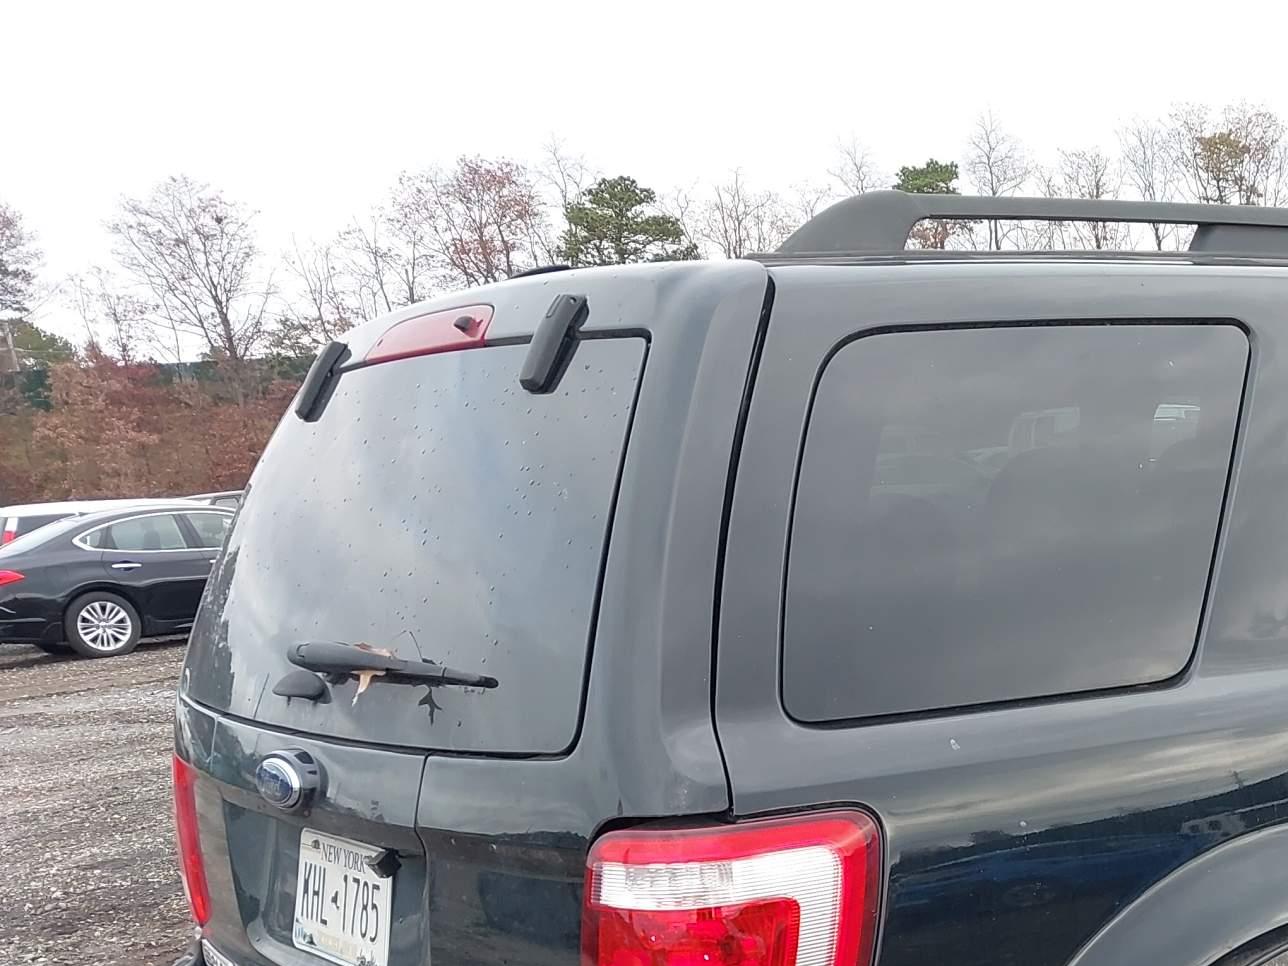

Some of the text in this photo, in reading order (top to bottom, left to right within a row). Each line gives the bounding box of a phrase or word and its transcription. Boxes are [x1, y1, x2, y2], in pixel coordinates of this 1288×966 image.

[320, 842, 367, 874] NEW YORK
[301, 860, 328, 926] KHL
[341, 873, 381, 944] 1785
